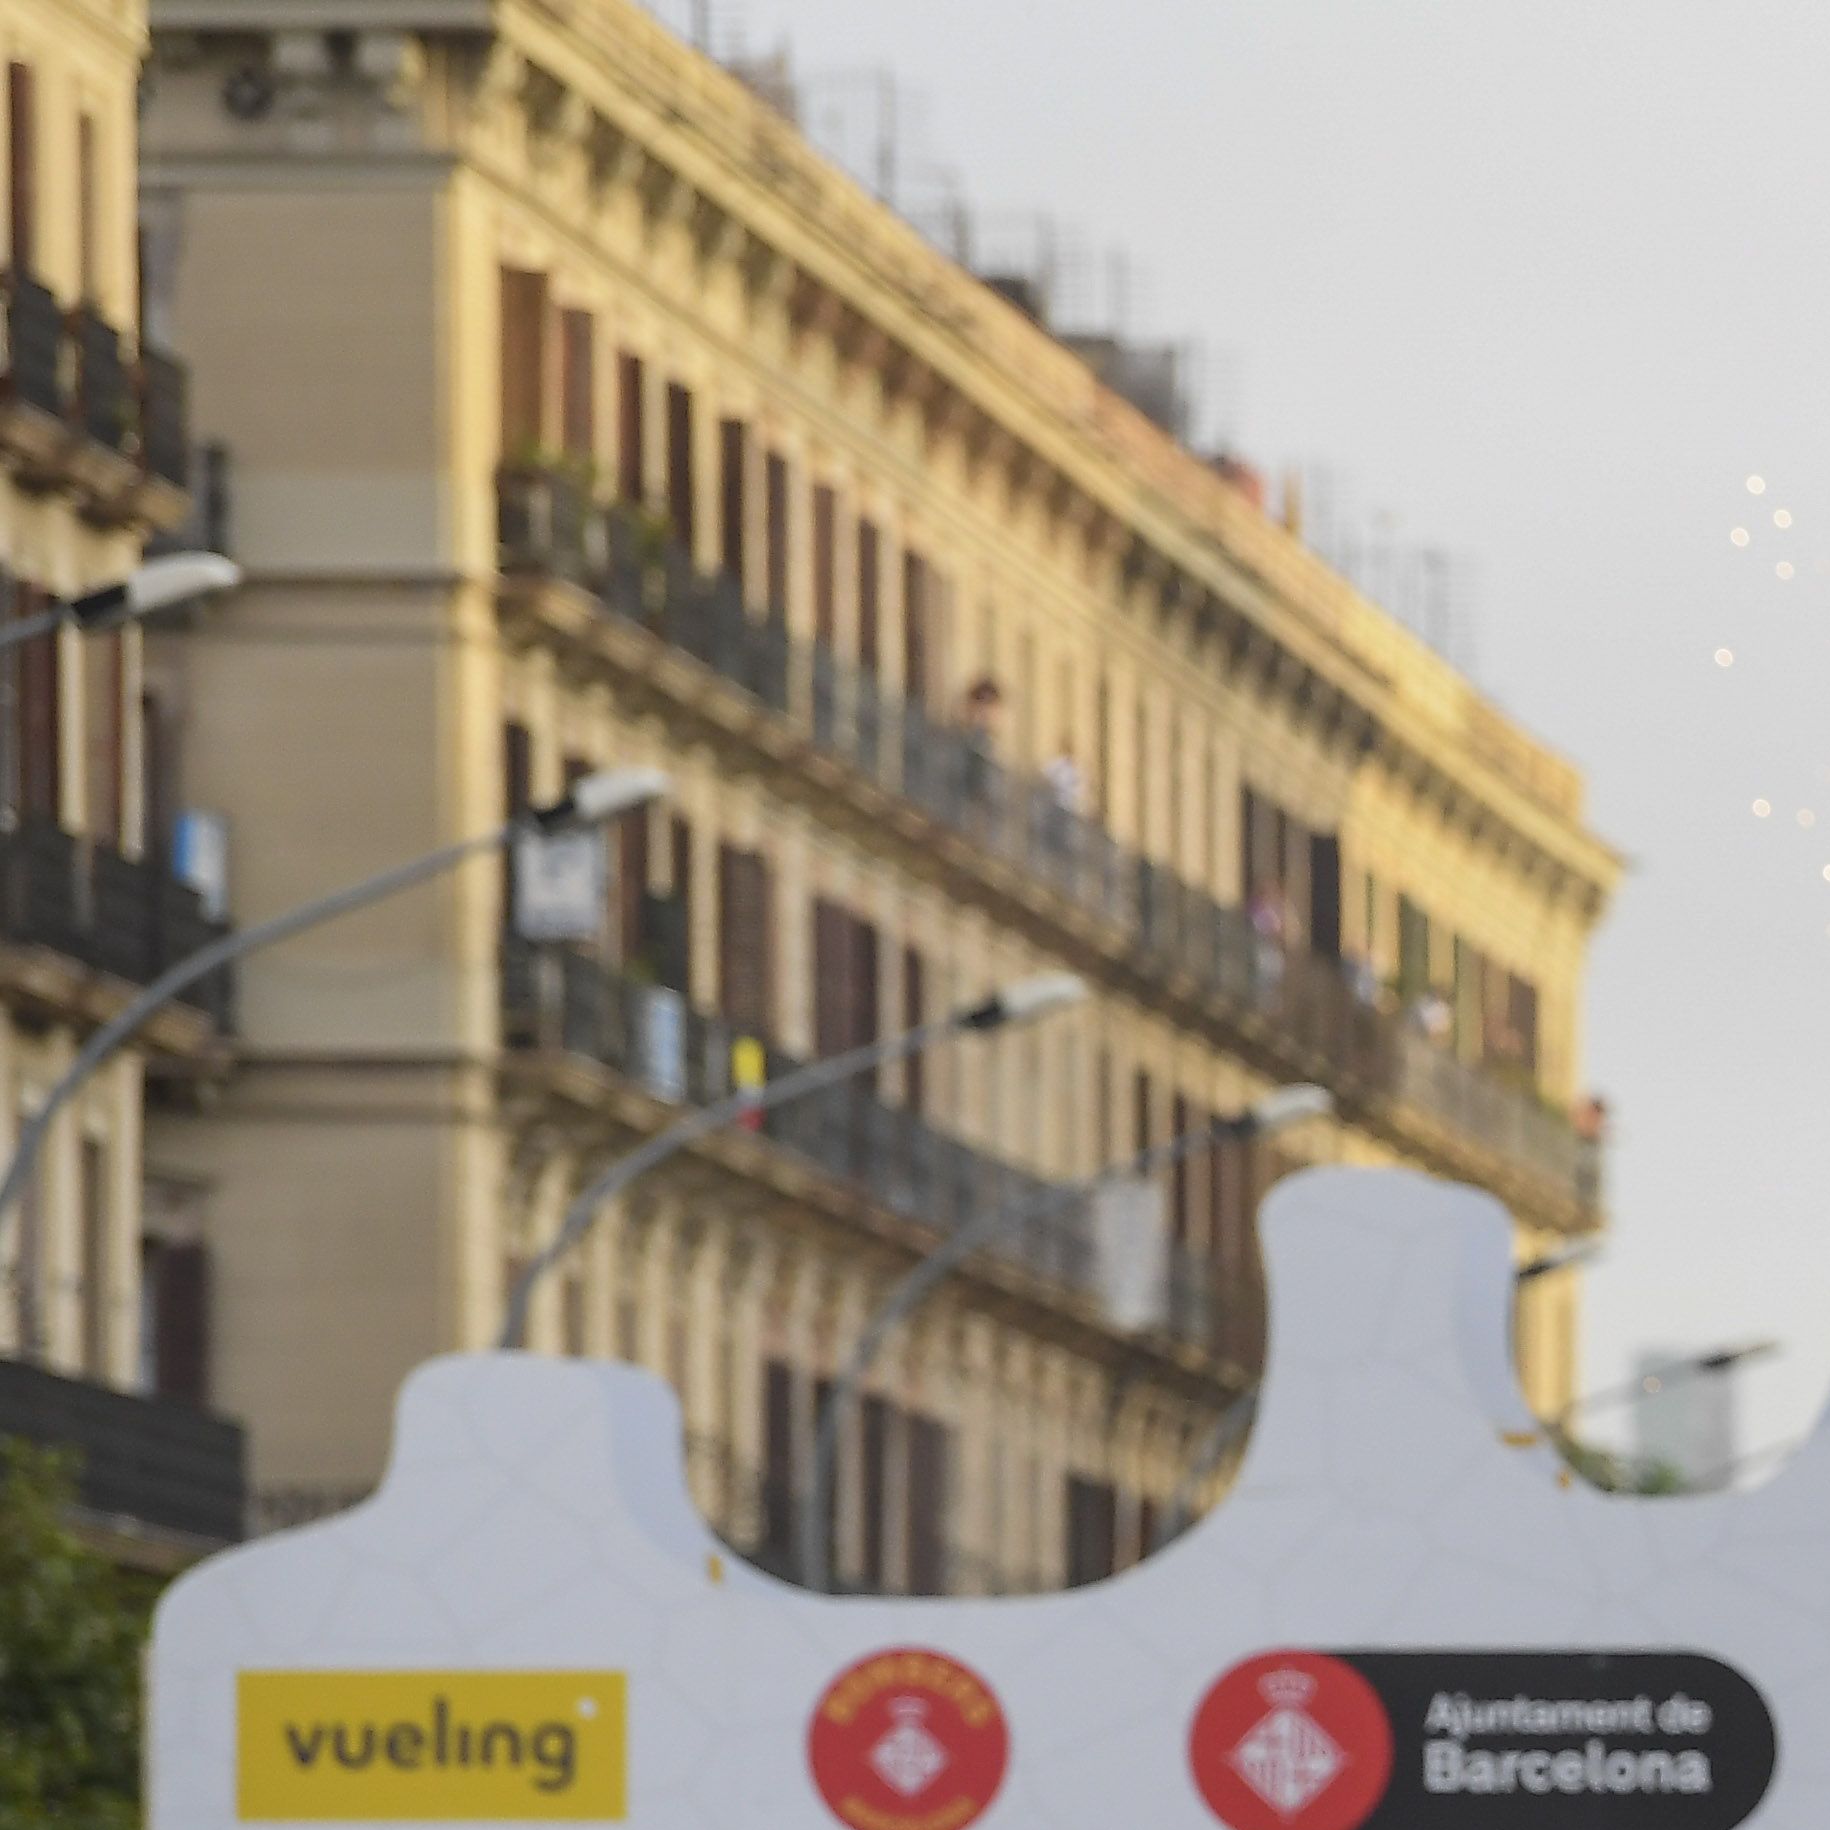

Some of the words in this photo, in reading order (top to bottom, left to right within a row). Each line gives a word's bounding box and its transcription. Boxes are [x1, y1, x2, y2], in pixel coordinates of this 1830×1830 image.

[1425, 1693, 1648, 1738] Ajuntament
[1657, 1693, 1712, 1734] de
[286, 1697, 577, 1791] vueling
[1424, 1742, 1712, 1795] Barcelona
